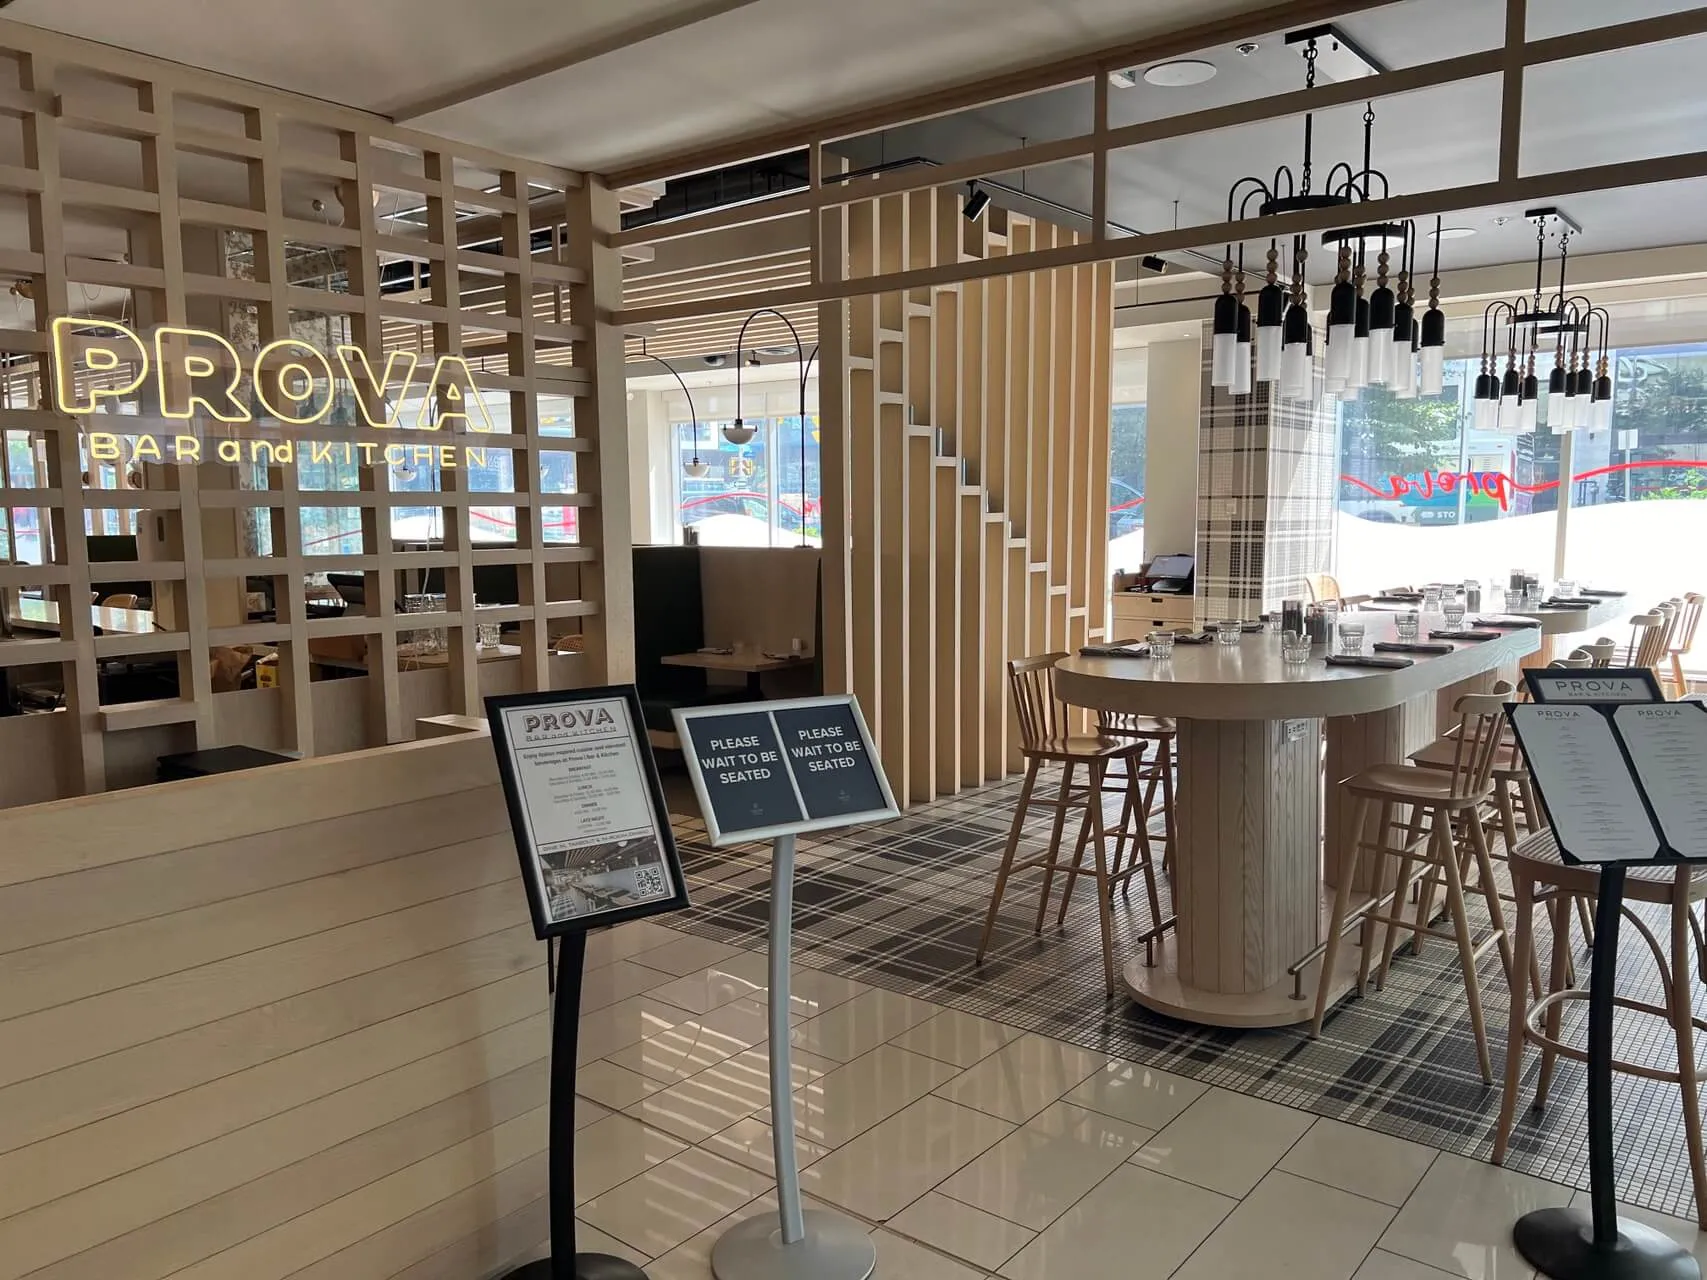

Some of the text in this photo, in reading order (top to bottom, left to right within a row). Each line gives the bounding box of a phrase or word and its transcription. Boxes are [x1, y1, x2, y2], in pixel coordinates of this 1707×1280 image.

[52, 316, 494, 434] PROVA
[89, 431, 488, 468] BAR and KITCHEN
[1555, 680, 1633, 692] PROVA
[522, 707, 615, 733] PROVA
[1637, 709, 1682, 717] PROVA
[798, 726, 843, 741] PLEASE
[710, 735, 760, 751] PLEASE
[791, 740, 862, 759] WAIT TO BE
[702, 750, 779, 769] WAIT TO BE
[808, 756, 856, 772] SEATED
[719, 768, 772, 784] SEATED
